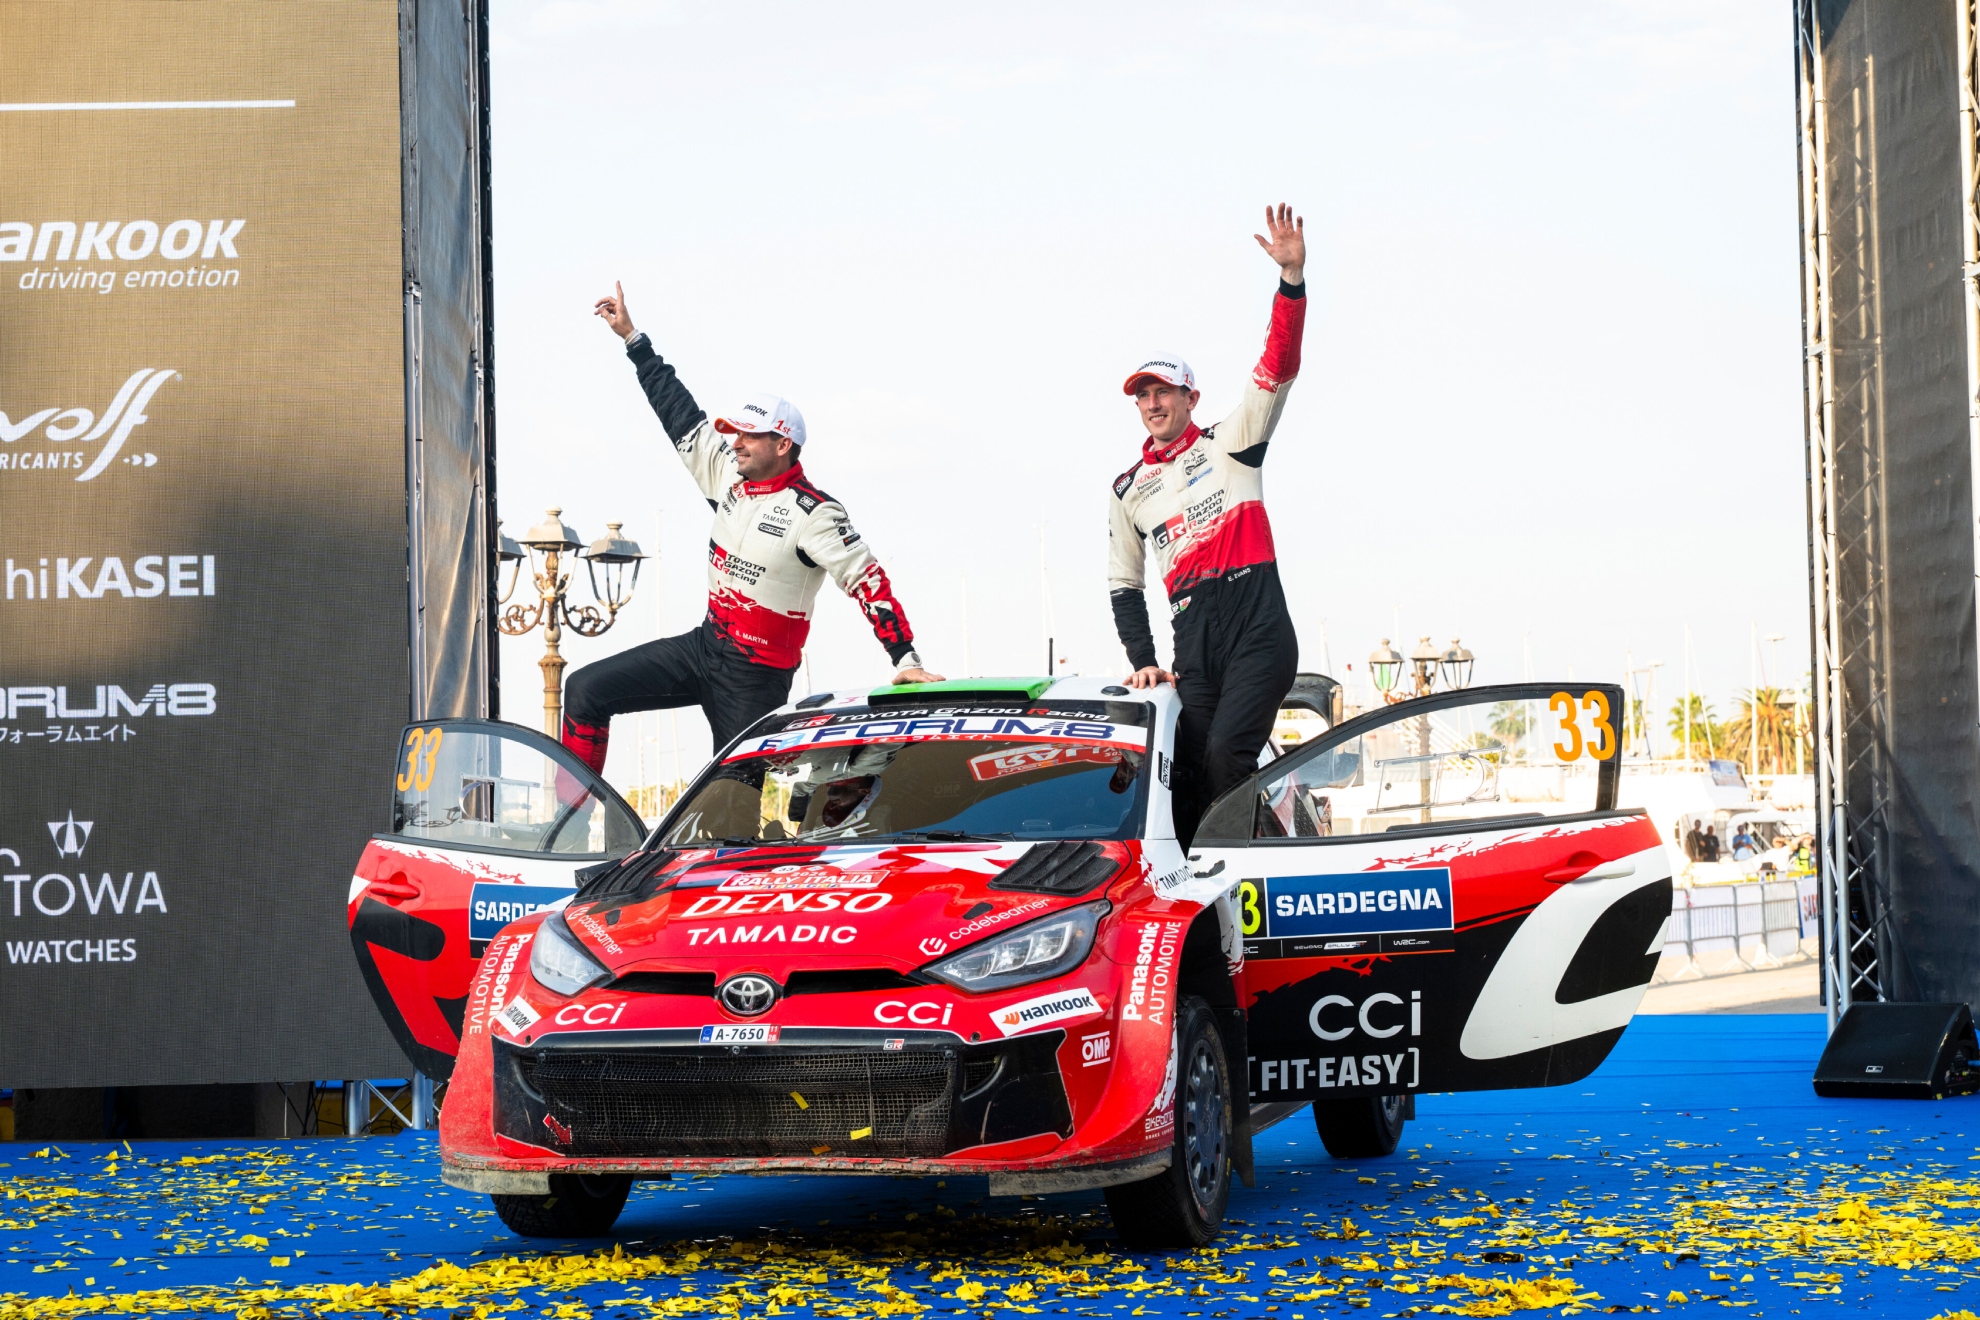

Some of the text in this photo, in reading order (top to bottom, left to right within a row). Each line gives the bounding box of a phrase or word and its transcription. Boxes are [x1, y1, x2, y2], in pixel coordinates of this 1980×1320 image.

[19, 264, 240, 294] driving emotion
[775, 420, 791, 435] 1st
[1134, 467, 1162, 487] DENSO
[799, 496, 815, 508] OMP
[1186, 489, 1224, 514] TOYOTA
[1187, 498, 1222, 522] GAZOO
[762, 513, 792, 526] TAMADIC
[1188, 505, 1223, 530] Racing
[1155, 522, 1187, 548] GR
[723, 561, 760, 578] GAZOO
[727, 554, 767, 573] TOYOTA
[6, 555, 216, 600] hiKASEI
[723, 568, 757, 585] Racing
[742, 632, 768, 645] MARTIN
[0, 683, 216, 719] RUM8
[785, 707, 1110, 731] GR TOYOTA GAZOO Racing
[811, 718, 1115, 743] FORUM8
[1549, 691, 1616, 762] 33
[397, 727, 443, 792] 33
[730, 874, 799, 886] RALLY
[802, 874, 872, 884] ITALIA
[1159, 865, 1194, 890] TAMADIC
[3, 871, 167, 917] TOWA
[680, 893, 893, 918] DENSO
[1276, 888, 1443, 917] SARDEGNA
[949, 898, 1050, 940] codebeamer
[578, 914, 623, 955] codebeamer
[686, 925, 857, 946] TAMADIC
[6, 938, 137, 964] WATCHES
[1122, 922, 1160, 1020] Panasonic
[1148, 922, 1181, 1025] AUTOMOTIVE
[469, 935, 511, 1034] AUTOMOTIVE
[715, 1028, 764, 1041] A-7650
[885, 1041, 903, 1049] GR
[1082, 1037, 1110, 1062] OMP
[1144, 1110, 1174, 1130] akebono
[1145, 1132, 1160, 1140] BRAKE
